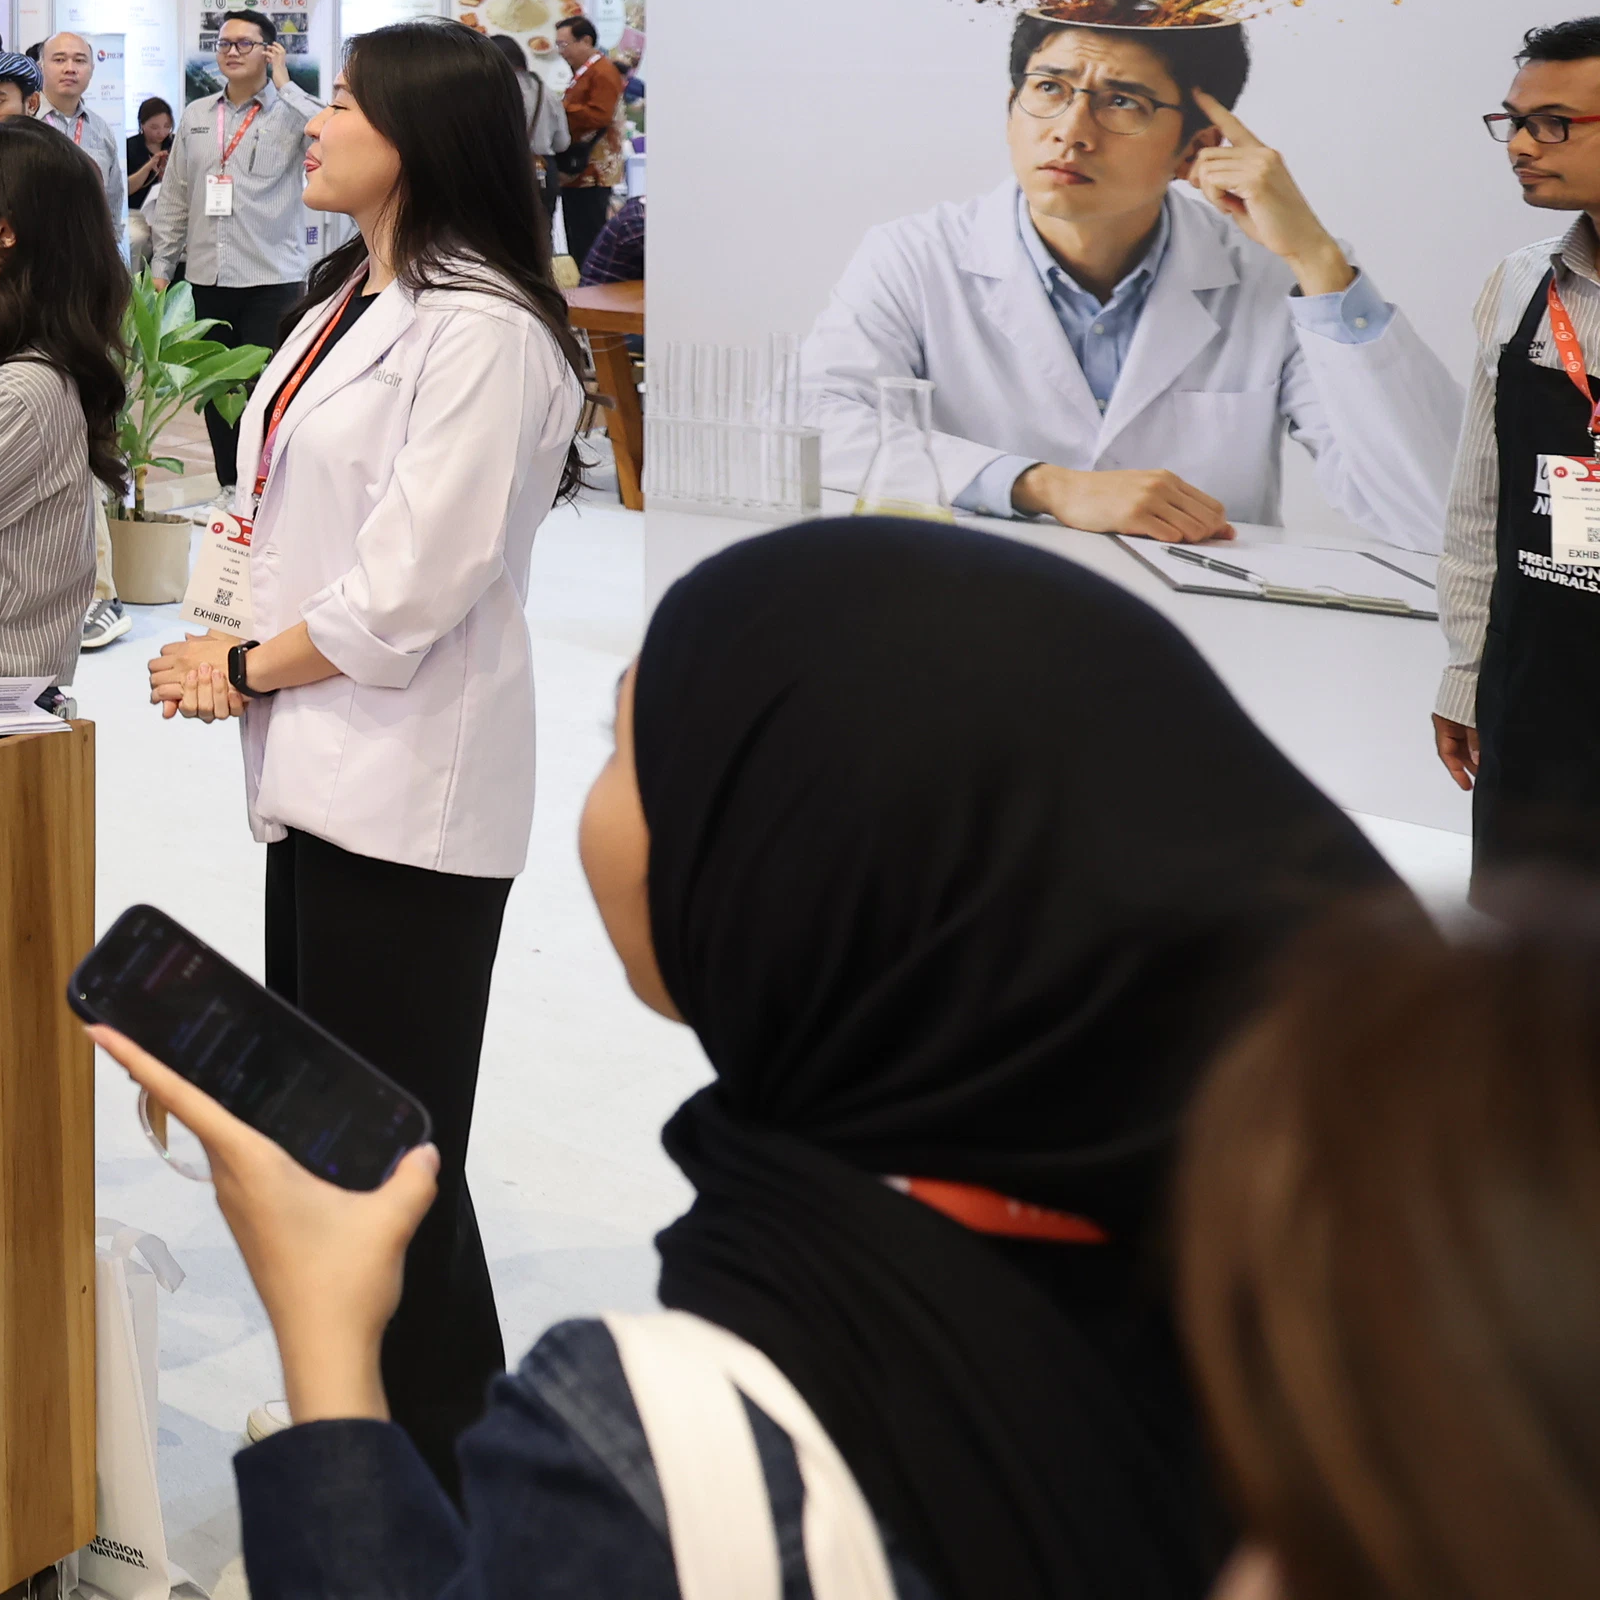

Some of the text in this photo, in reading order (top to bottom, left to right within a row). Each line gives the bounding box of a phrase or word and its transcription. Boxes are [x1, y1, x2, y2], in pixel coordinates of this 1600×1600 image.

[1518, 549, 1600, 581] PRECISION
[1569, 549, 1600, 560] EXHIB
[193, 607, 242, 629] EXHIBITOR
[90, 1543, 149, 1570] NATURALS.
[92, 1534, 144, 1560] ECISION
